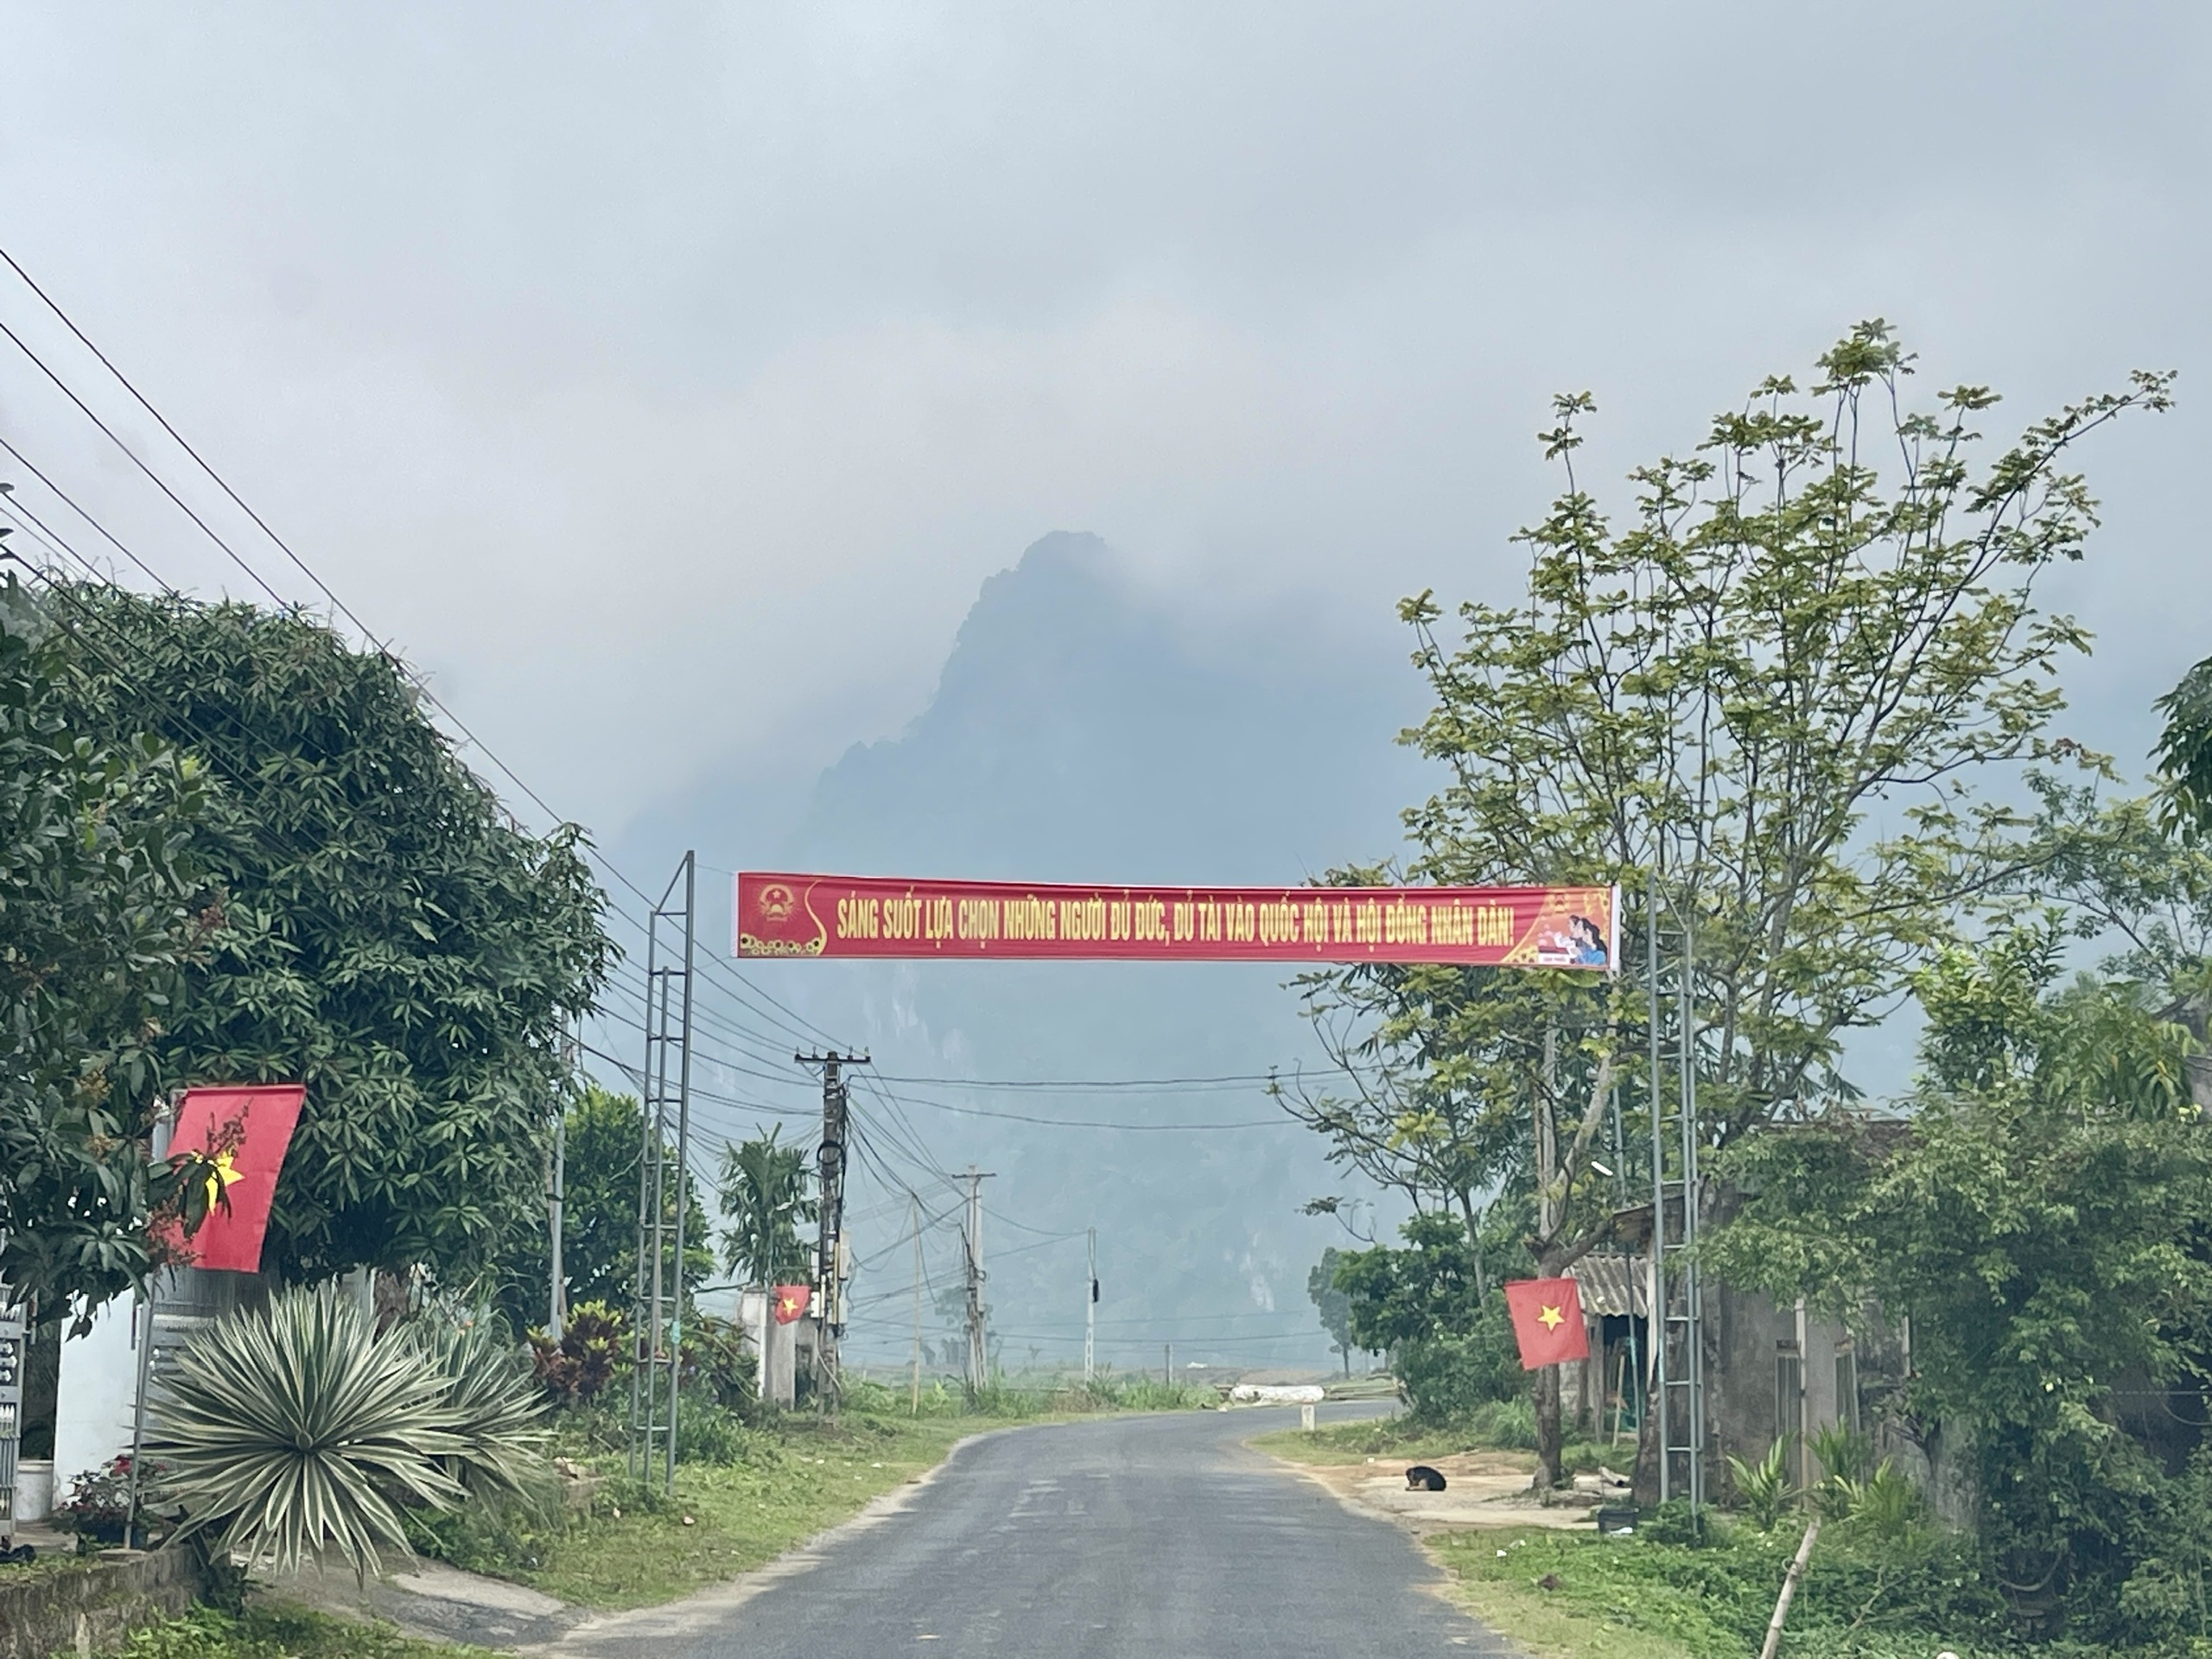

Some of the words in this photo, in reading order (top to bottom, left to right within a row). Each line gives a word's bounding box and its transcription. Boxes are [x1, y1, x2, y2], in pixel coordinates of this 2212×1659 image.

[836, 890, 879, 939] SÁNG
[882, 885, 922, 939] SUỐT
[925, 895, 954, 949] LỰA
[958, 899, 1000, 949] CHỌN
[1003, 893, 1056, 940] NHỮNG
[1059, 892, 1107, 940] NGƯỜI
[1110, 888, 1131, 941] ĐỦ
[1135, 893, 1170, 947] ĐỨC,
[1198, 894, 1222, 942] TÀI
[1225, 895, 1255, 943] VÀO
[1259, 890, 1300, 947] QUỐC
[1303, 897, 1329, 952] HỘI
[1332, 897, 1352, 944] VÀ
[1356, 897, 1382, 953] HỘI
[1431, 898, 1473, 946] NHÂN
[1478, 899, 1514, 946] DÂN!
